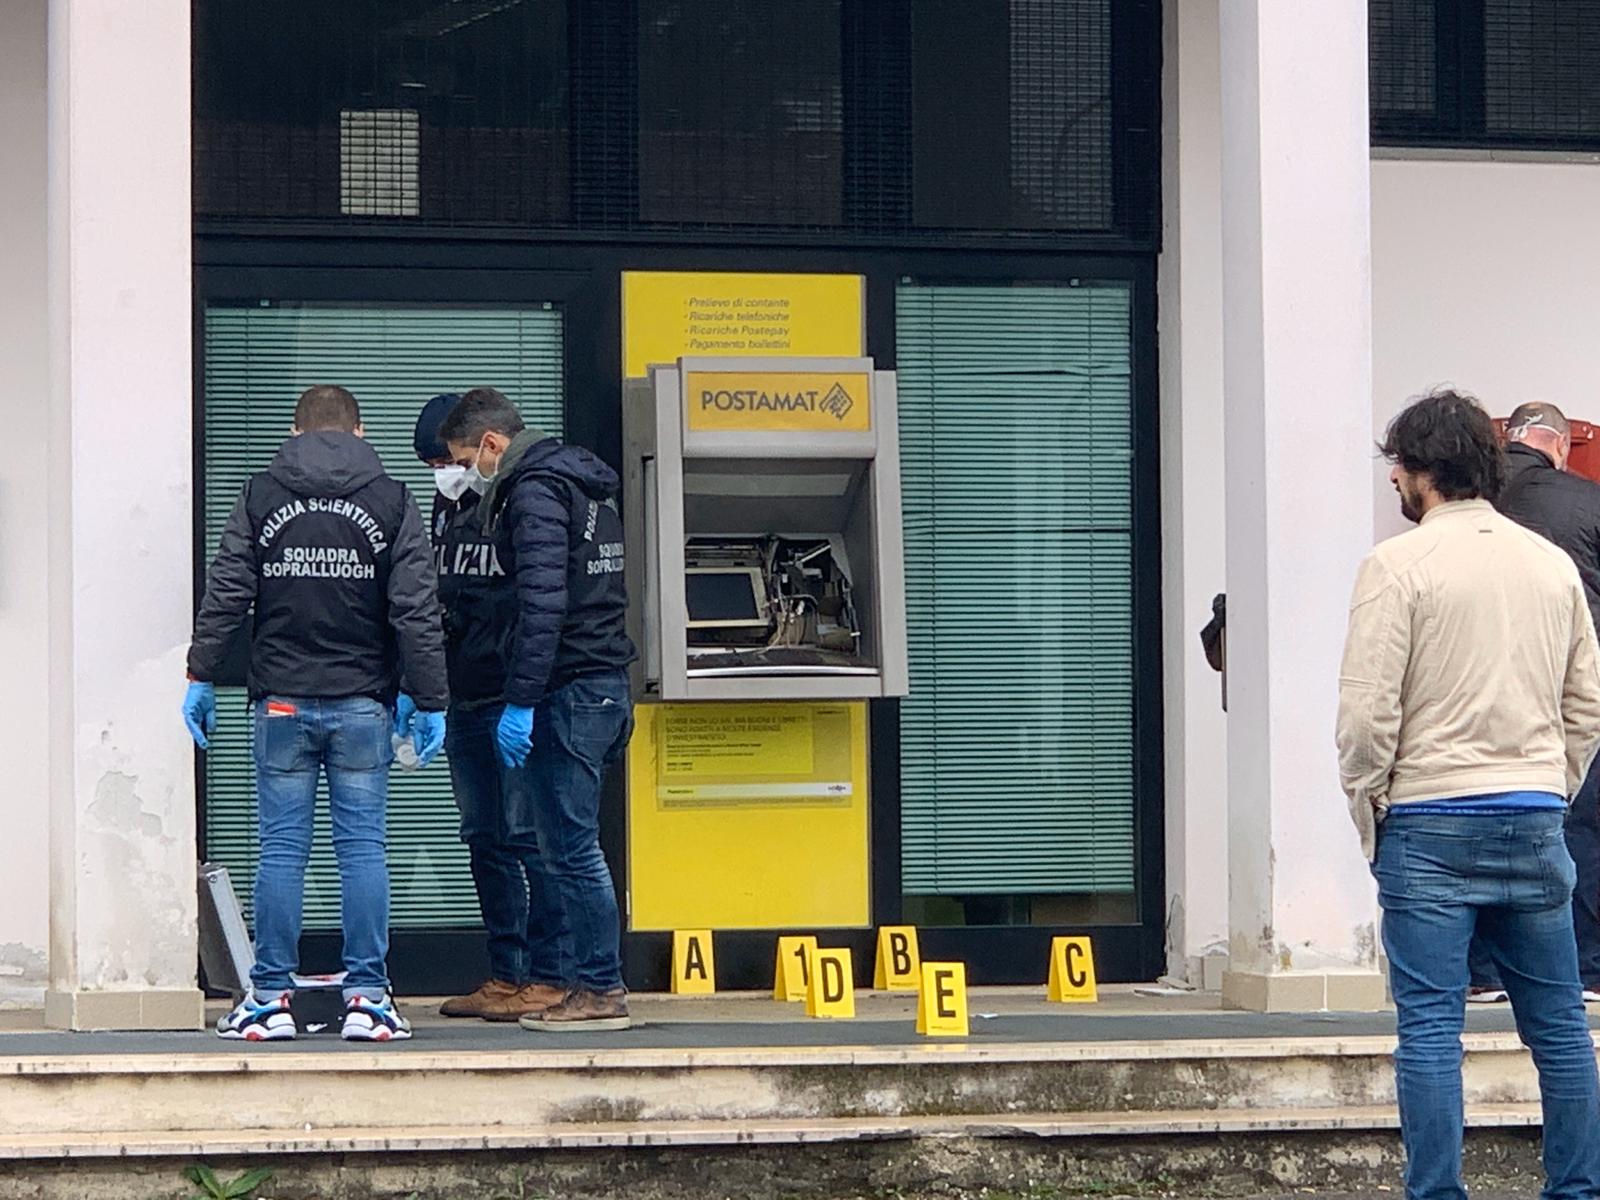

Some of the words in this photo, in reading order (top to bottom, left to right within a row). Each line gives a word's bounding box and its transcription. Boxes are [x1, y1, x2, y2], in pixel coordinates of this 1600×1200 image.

[688, 297, 731, 308] Prelievo
[732, 298, 743, 308] di
[688, 311, 734, 321] Ricariche
[736, 311, 790, 321] telefoniche
[689, 325, 739, 336] Ricariche
[741, 325, 790, 337] Postepay
[689, 339, 746, 350] Pagamento
[701, 390, 819, 412] POSTAMAT
[259, 500, 306, 548] POLIZIA
[308, 498, 388, 554] SCIENTIFICA
[262, 562, 375, 579] SOPRALLUOGH
[283, 547, 359, 564] SQUADRA
[684, 936, 708, 980] A
[794, 943, 808, 986] 1
[890, 932, 912, 976] B
[1065, 942, 1087, 988] C
[820, 957, 844, 1003] D
[934, 970, 957, 1018] E
